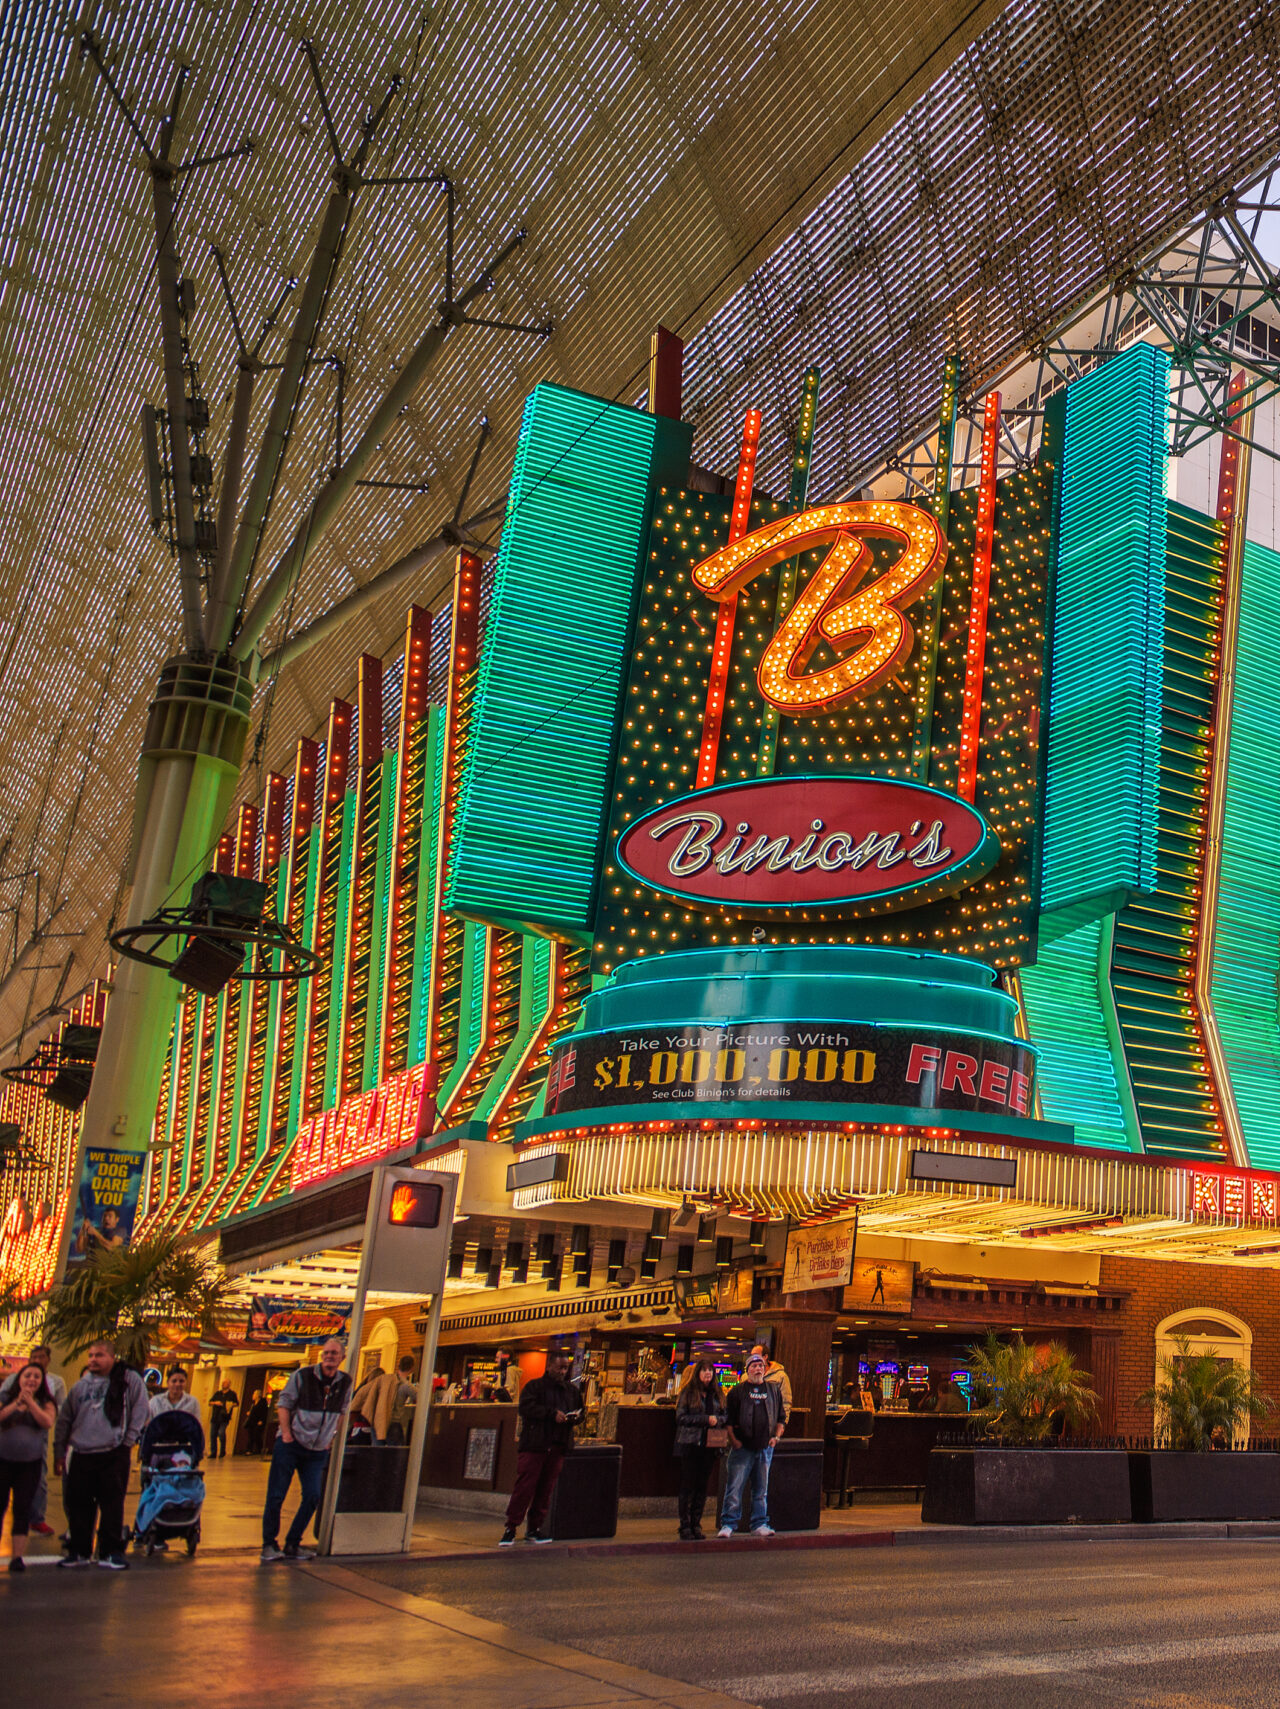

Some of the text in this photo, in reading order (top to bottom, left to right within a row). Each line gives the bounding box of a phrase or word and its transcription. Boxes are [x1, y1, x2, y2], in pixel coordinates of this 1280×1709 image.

[692, 500, 945, 713] B
[650, 810, 952, 877] Binion's
[620, 1032, 850, 1052] Take Your Picture With
[593, 1048, 877, 1091] $1,000,000
[905, 1043, 1030, 1115] FREE
[652, 1087, 791, 1099] See Club Binion's for details
[90, 1152, 141, 1165] WE TRIPLE
[98, 1163, 129, 1178] DOG
[91, 1177, 131, 1192] DARE
[94, 1191, 123, 1206] YOU
[807, 1238, 834, 1254] Purchase
[809, 1255, 844, 1272] Drinks Here
[276, 1325, 339, 1335] UNLEASHED
